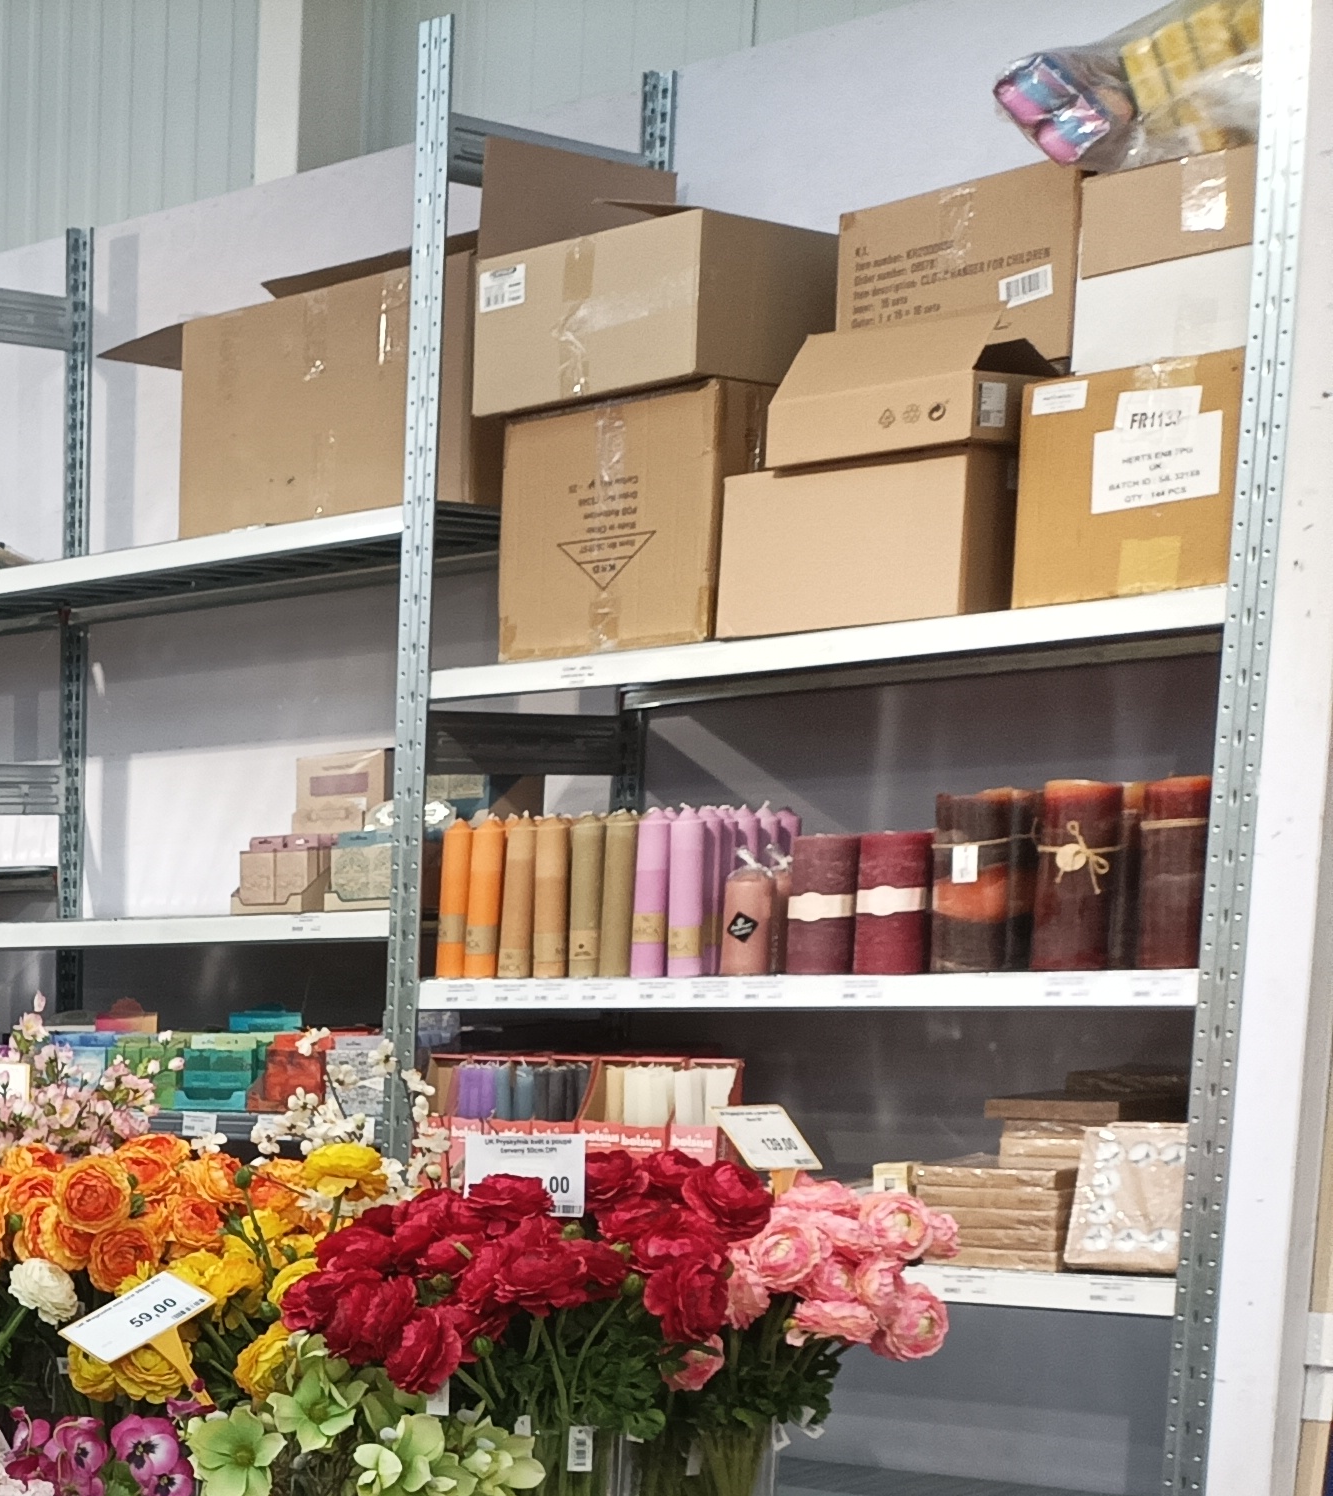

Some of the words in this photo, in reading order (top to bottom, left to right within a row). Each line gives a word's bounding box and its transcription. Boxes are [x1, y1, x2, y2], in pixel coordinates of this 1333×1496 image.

[987, 256, 1005, 272] FOR
[1005, 247, 1051, 267] CHILDREN
[1167, 486, 1188, 496] PCS
[620, 1132, 663, 1148] bolsius
[671, 1133, 714, 1149] bolsius
[129, 1297, 178, 1328] 59,00
